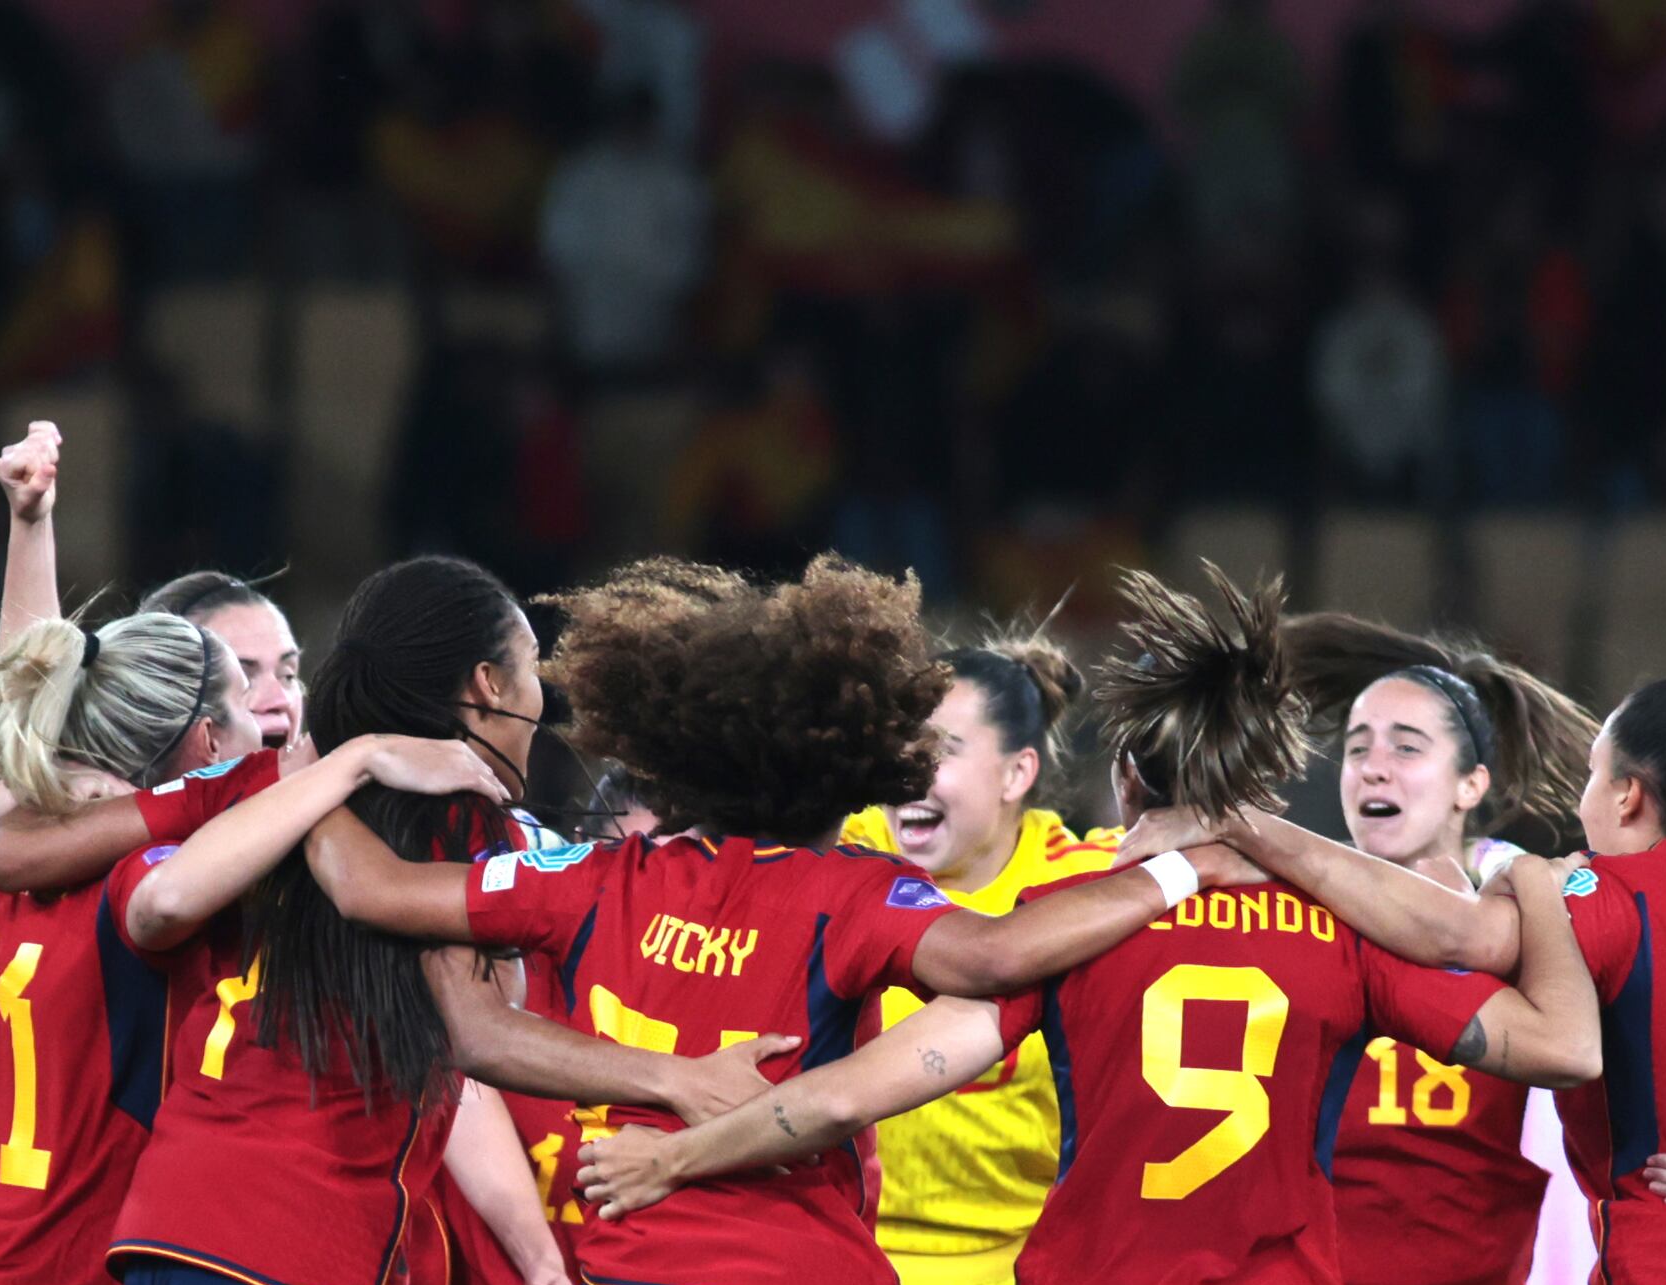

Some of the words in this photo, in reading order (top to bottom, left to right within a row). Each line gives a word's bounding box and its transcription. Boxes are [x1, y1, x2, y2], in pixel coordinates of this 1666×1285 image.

[640, 913, 759, 977] VICKY
[1149, 892, 1335, 943] DONDO
[1141, 964, 1289, 1200] 9
[1365, 1036, 1470, 1127] 18
